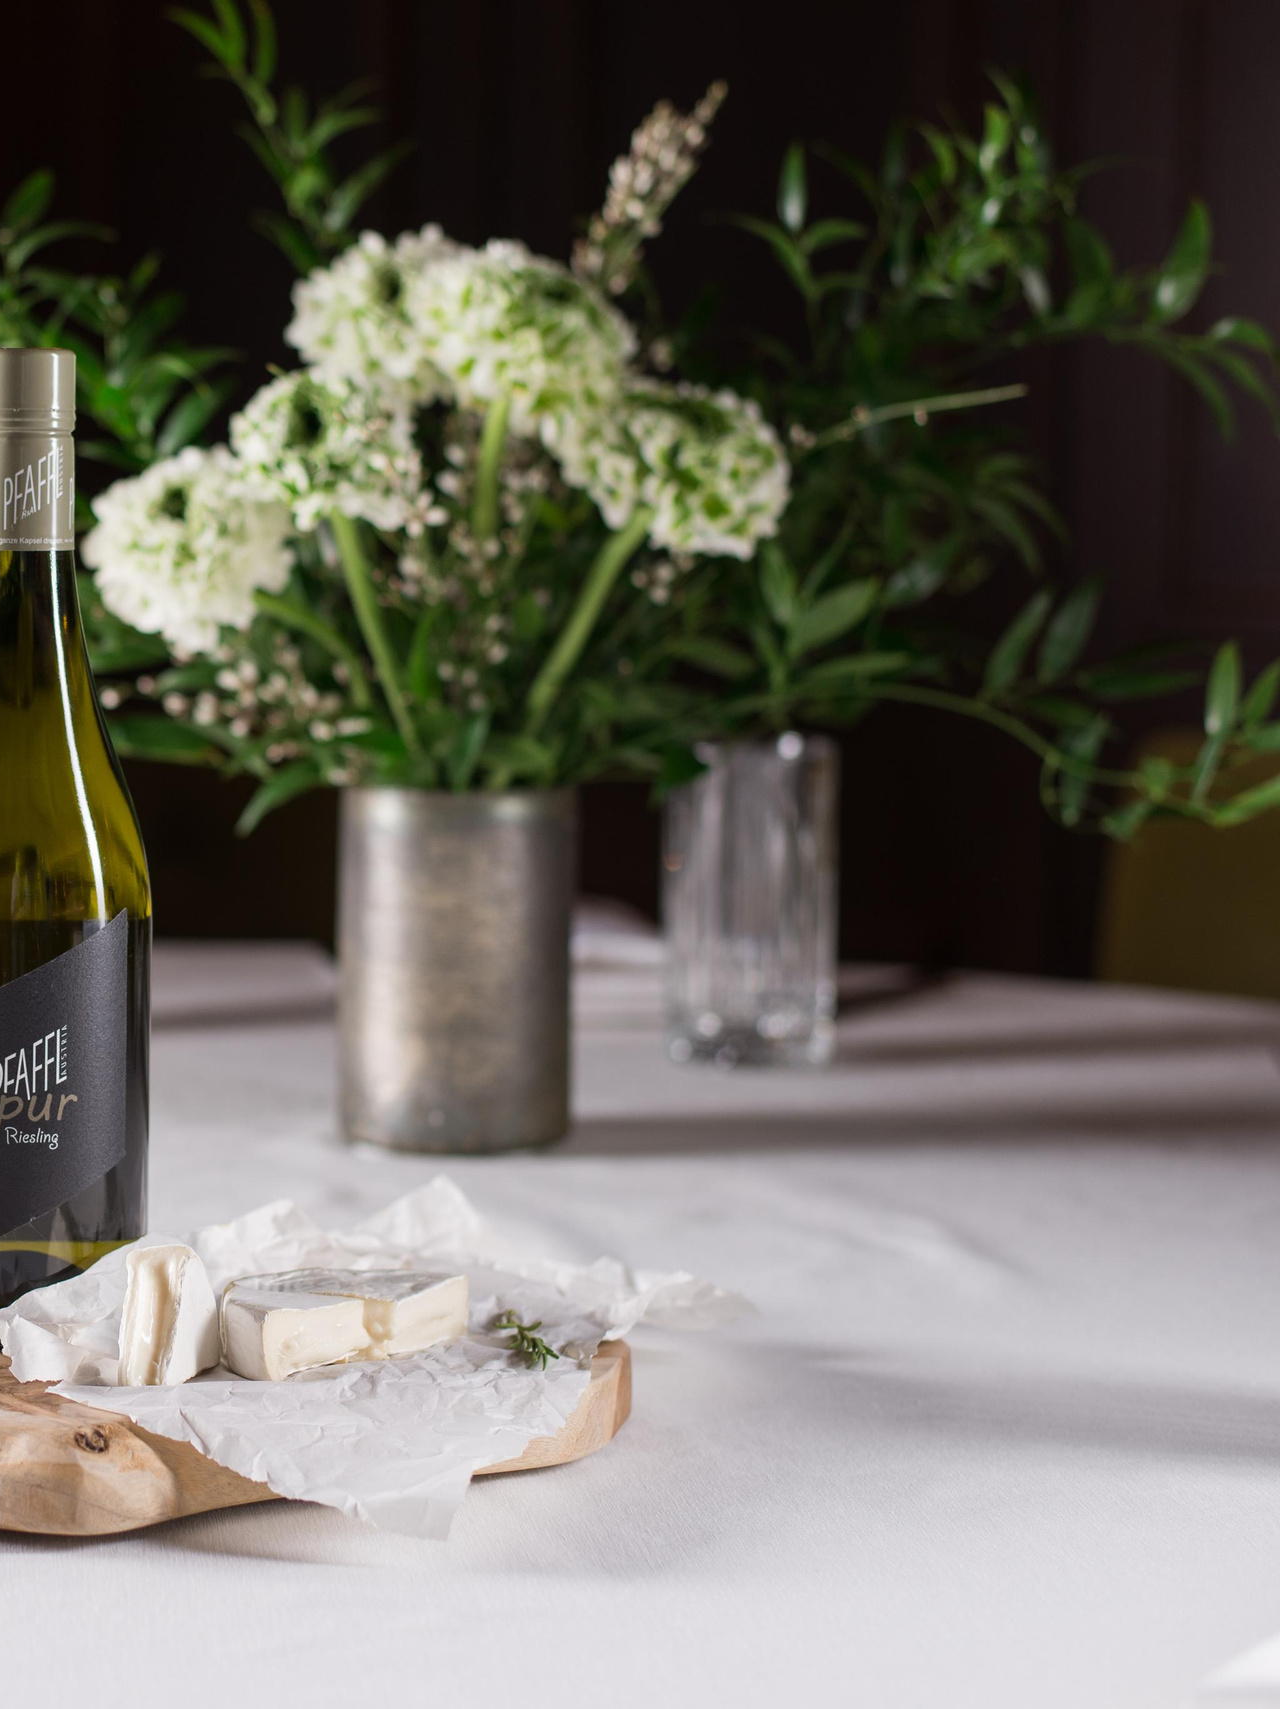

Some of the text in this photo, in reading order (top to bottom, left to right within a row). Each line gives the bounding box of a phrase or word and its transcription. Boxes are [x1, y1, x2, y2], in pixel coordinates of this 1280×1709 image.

[3, 447, 63, 530] PFAFFL
[20, 537, 42, 545] Kapsel
[60, 1024, 68, 1076] AUSTRIA
[4, 1126, 59, 1150] Riesling
